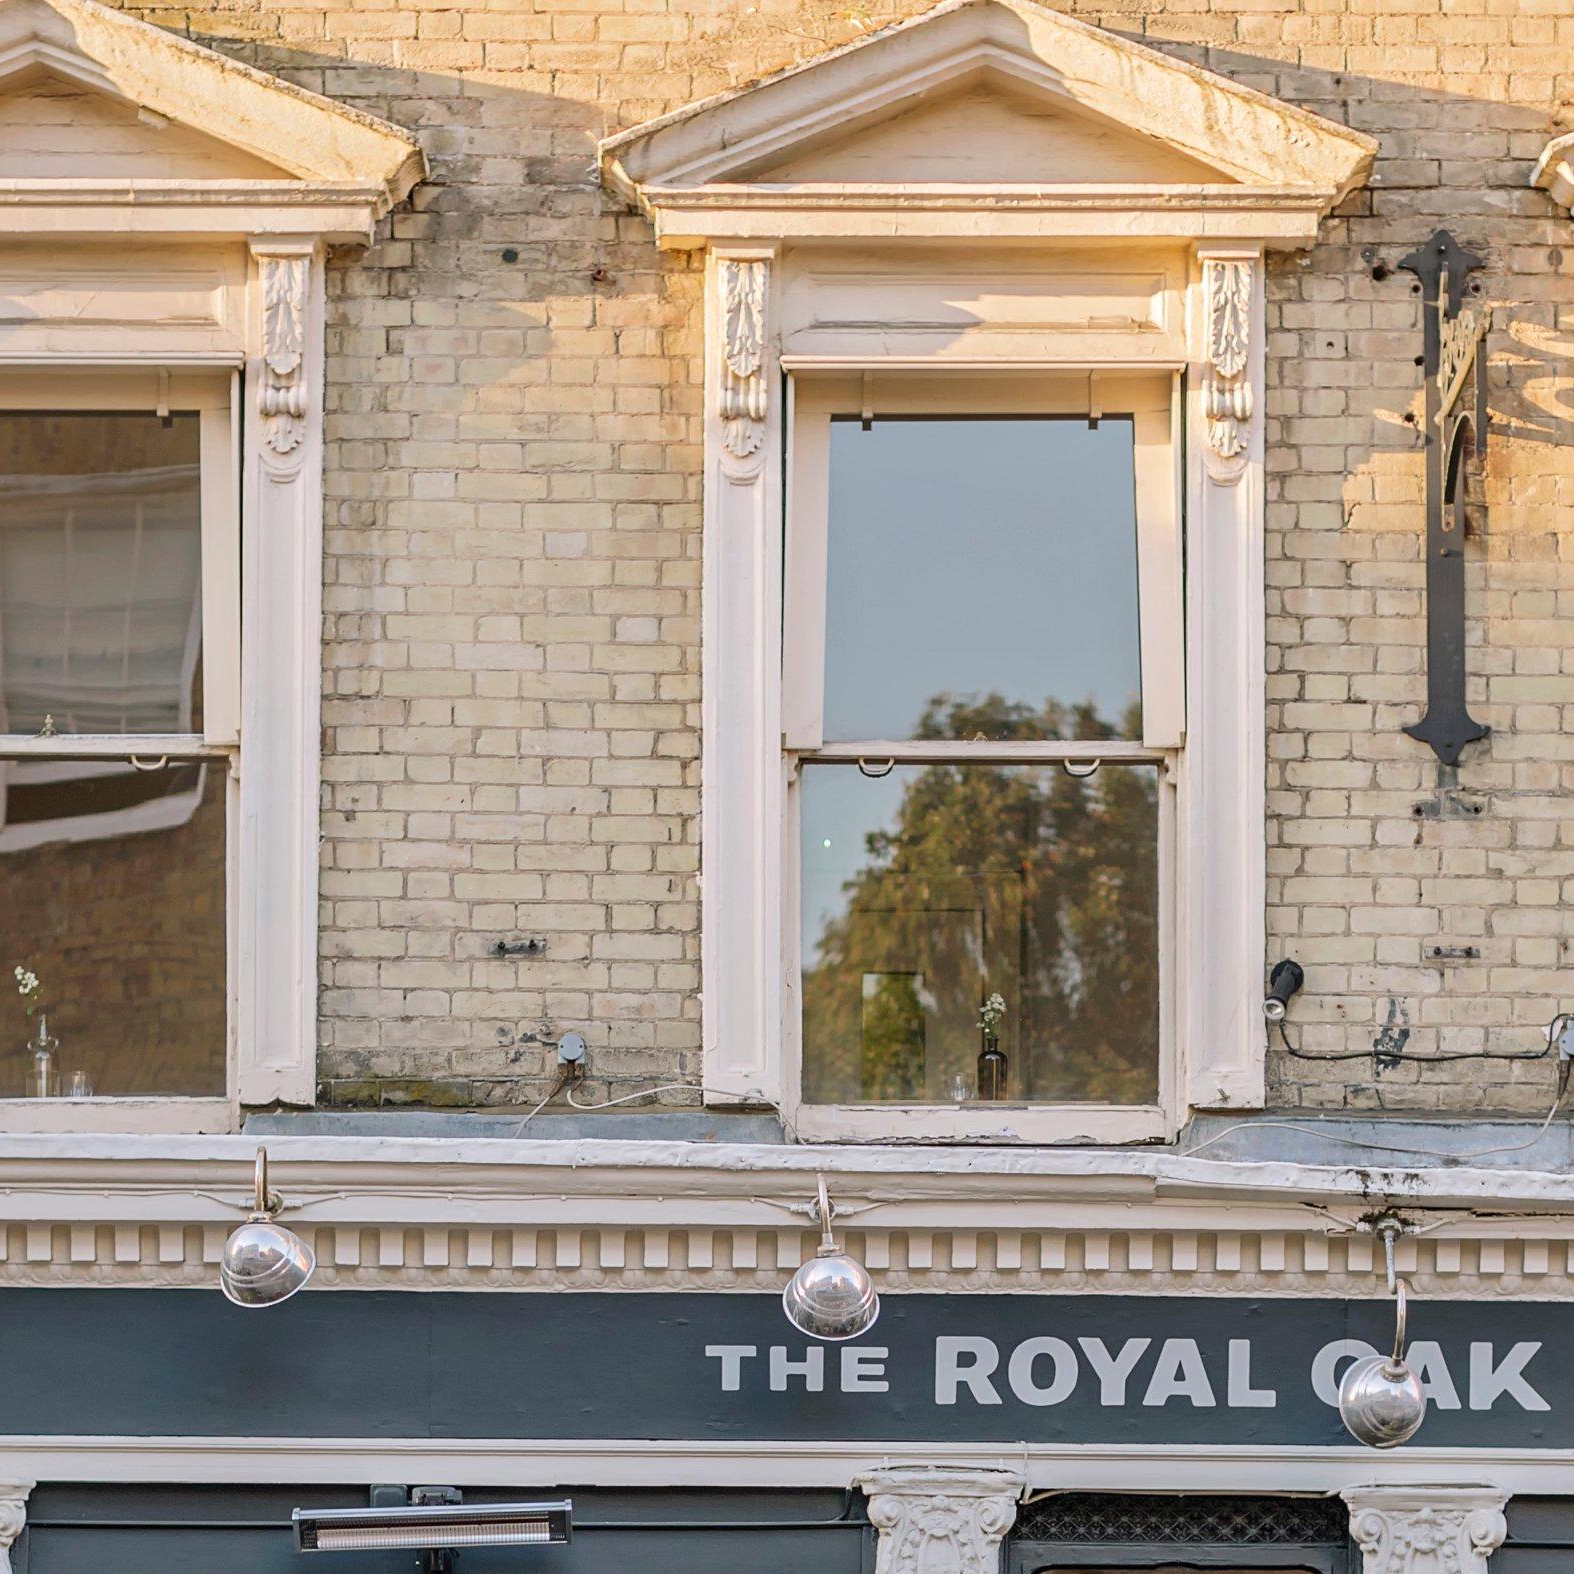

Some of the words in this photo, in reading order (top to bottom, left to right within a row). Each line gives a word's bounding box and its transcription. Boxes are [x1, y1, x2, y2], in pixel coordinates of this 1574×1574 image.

[705, 1344, 890, 1393] THE
[935, 1335, 1277, 1408] ROYAL
[1311, 1338, 1552, 1412] OAK
